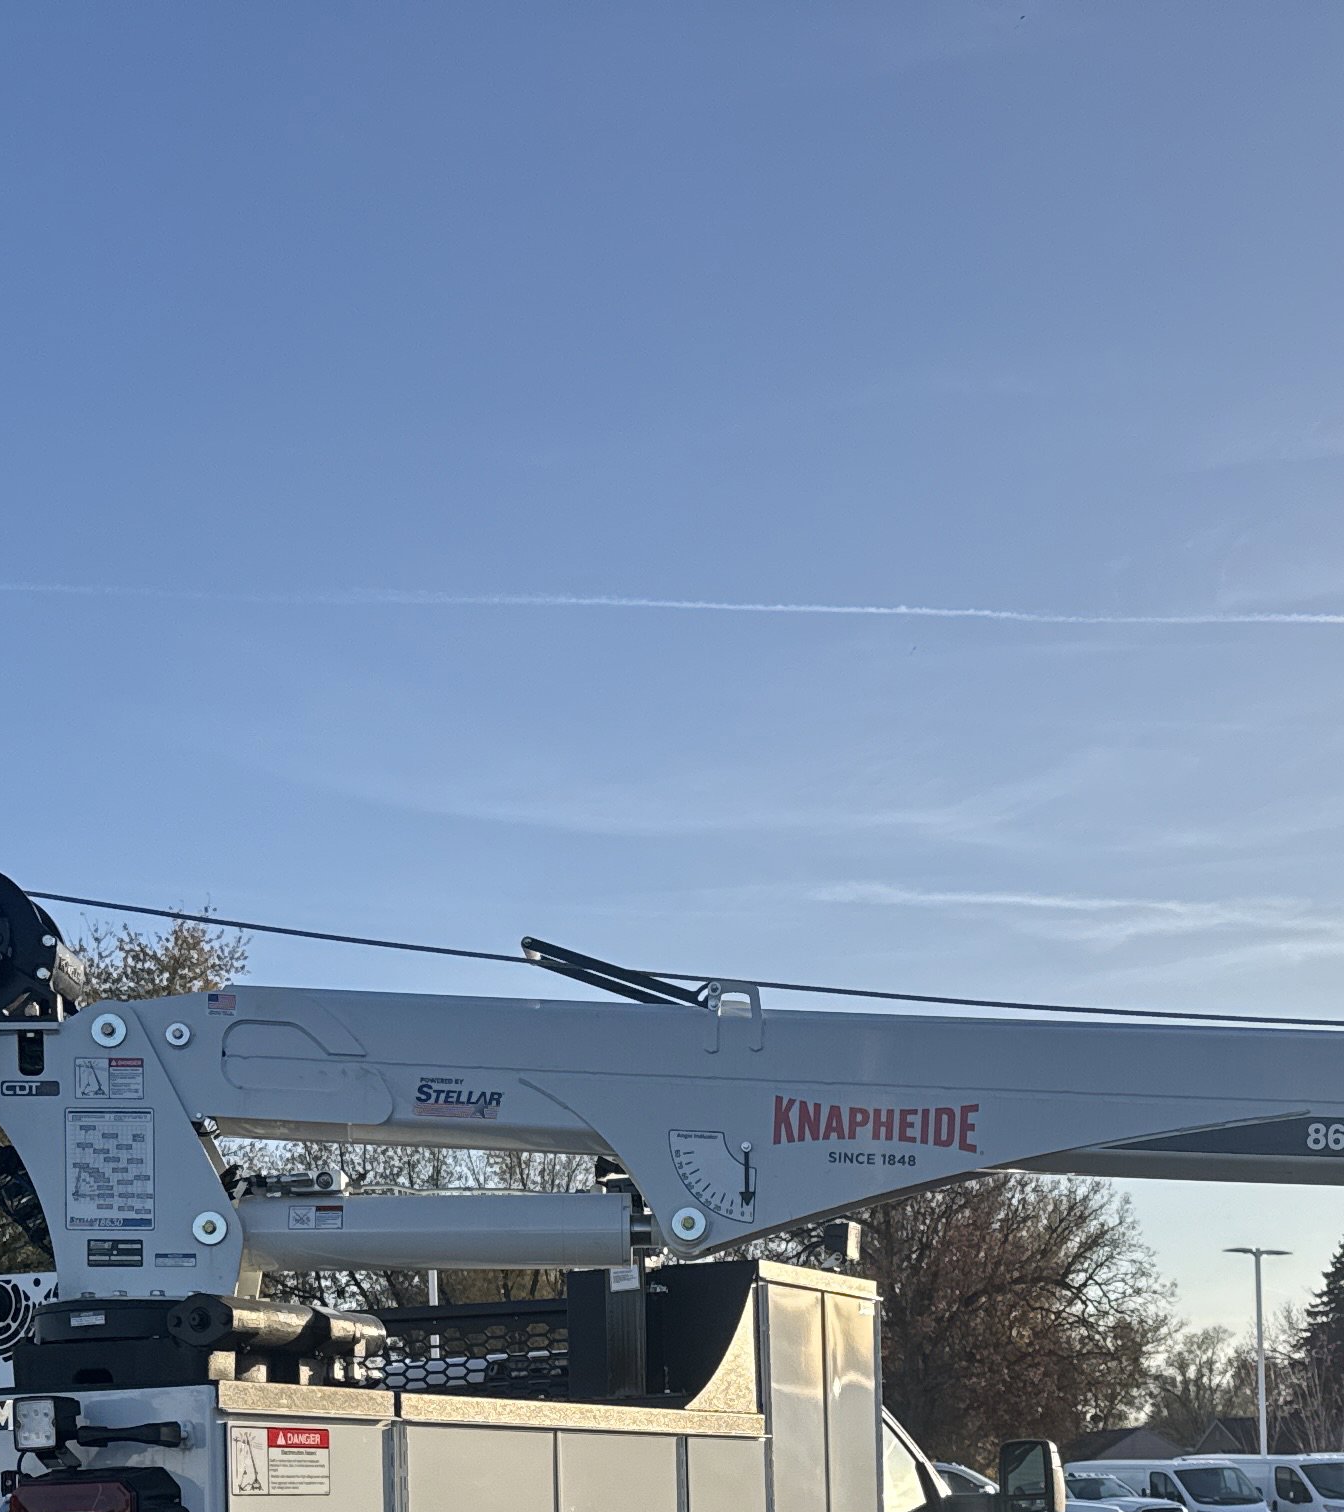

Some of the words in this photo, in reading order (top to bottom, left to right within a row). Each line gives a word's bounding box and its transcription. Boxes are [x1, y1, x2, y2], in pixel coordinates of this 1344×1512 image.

[2, 1082, 41, 1095] CDT
[773, 1095, 979, 1154] KNAPHEIDE
[828, 1151, 876, 1165] SINCE
[881, 1153, 917, 1167] 1848
[287, 1433, 321, 1445] DANGER
